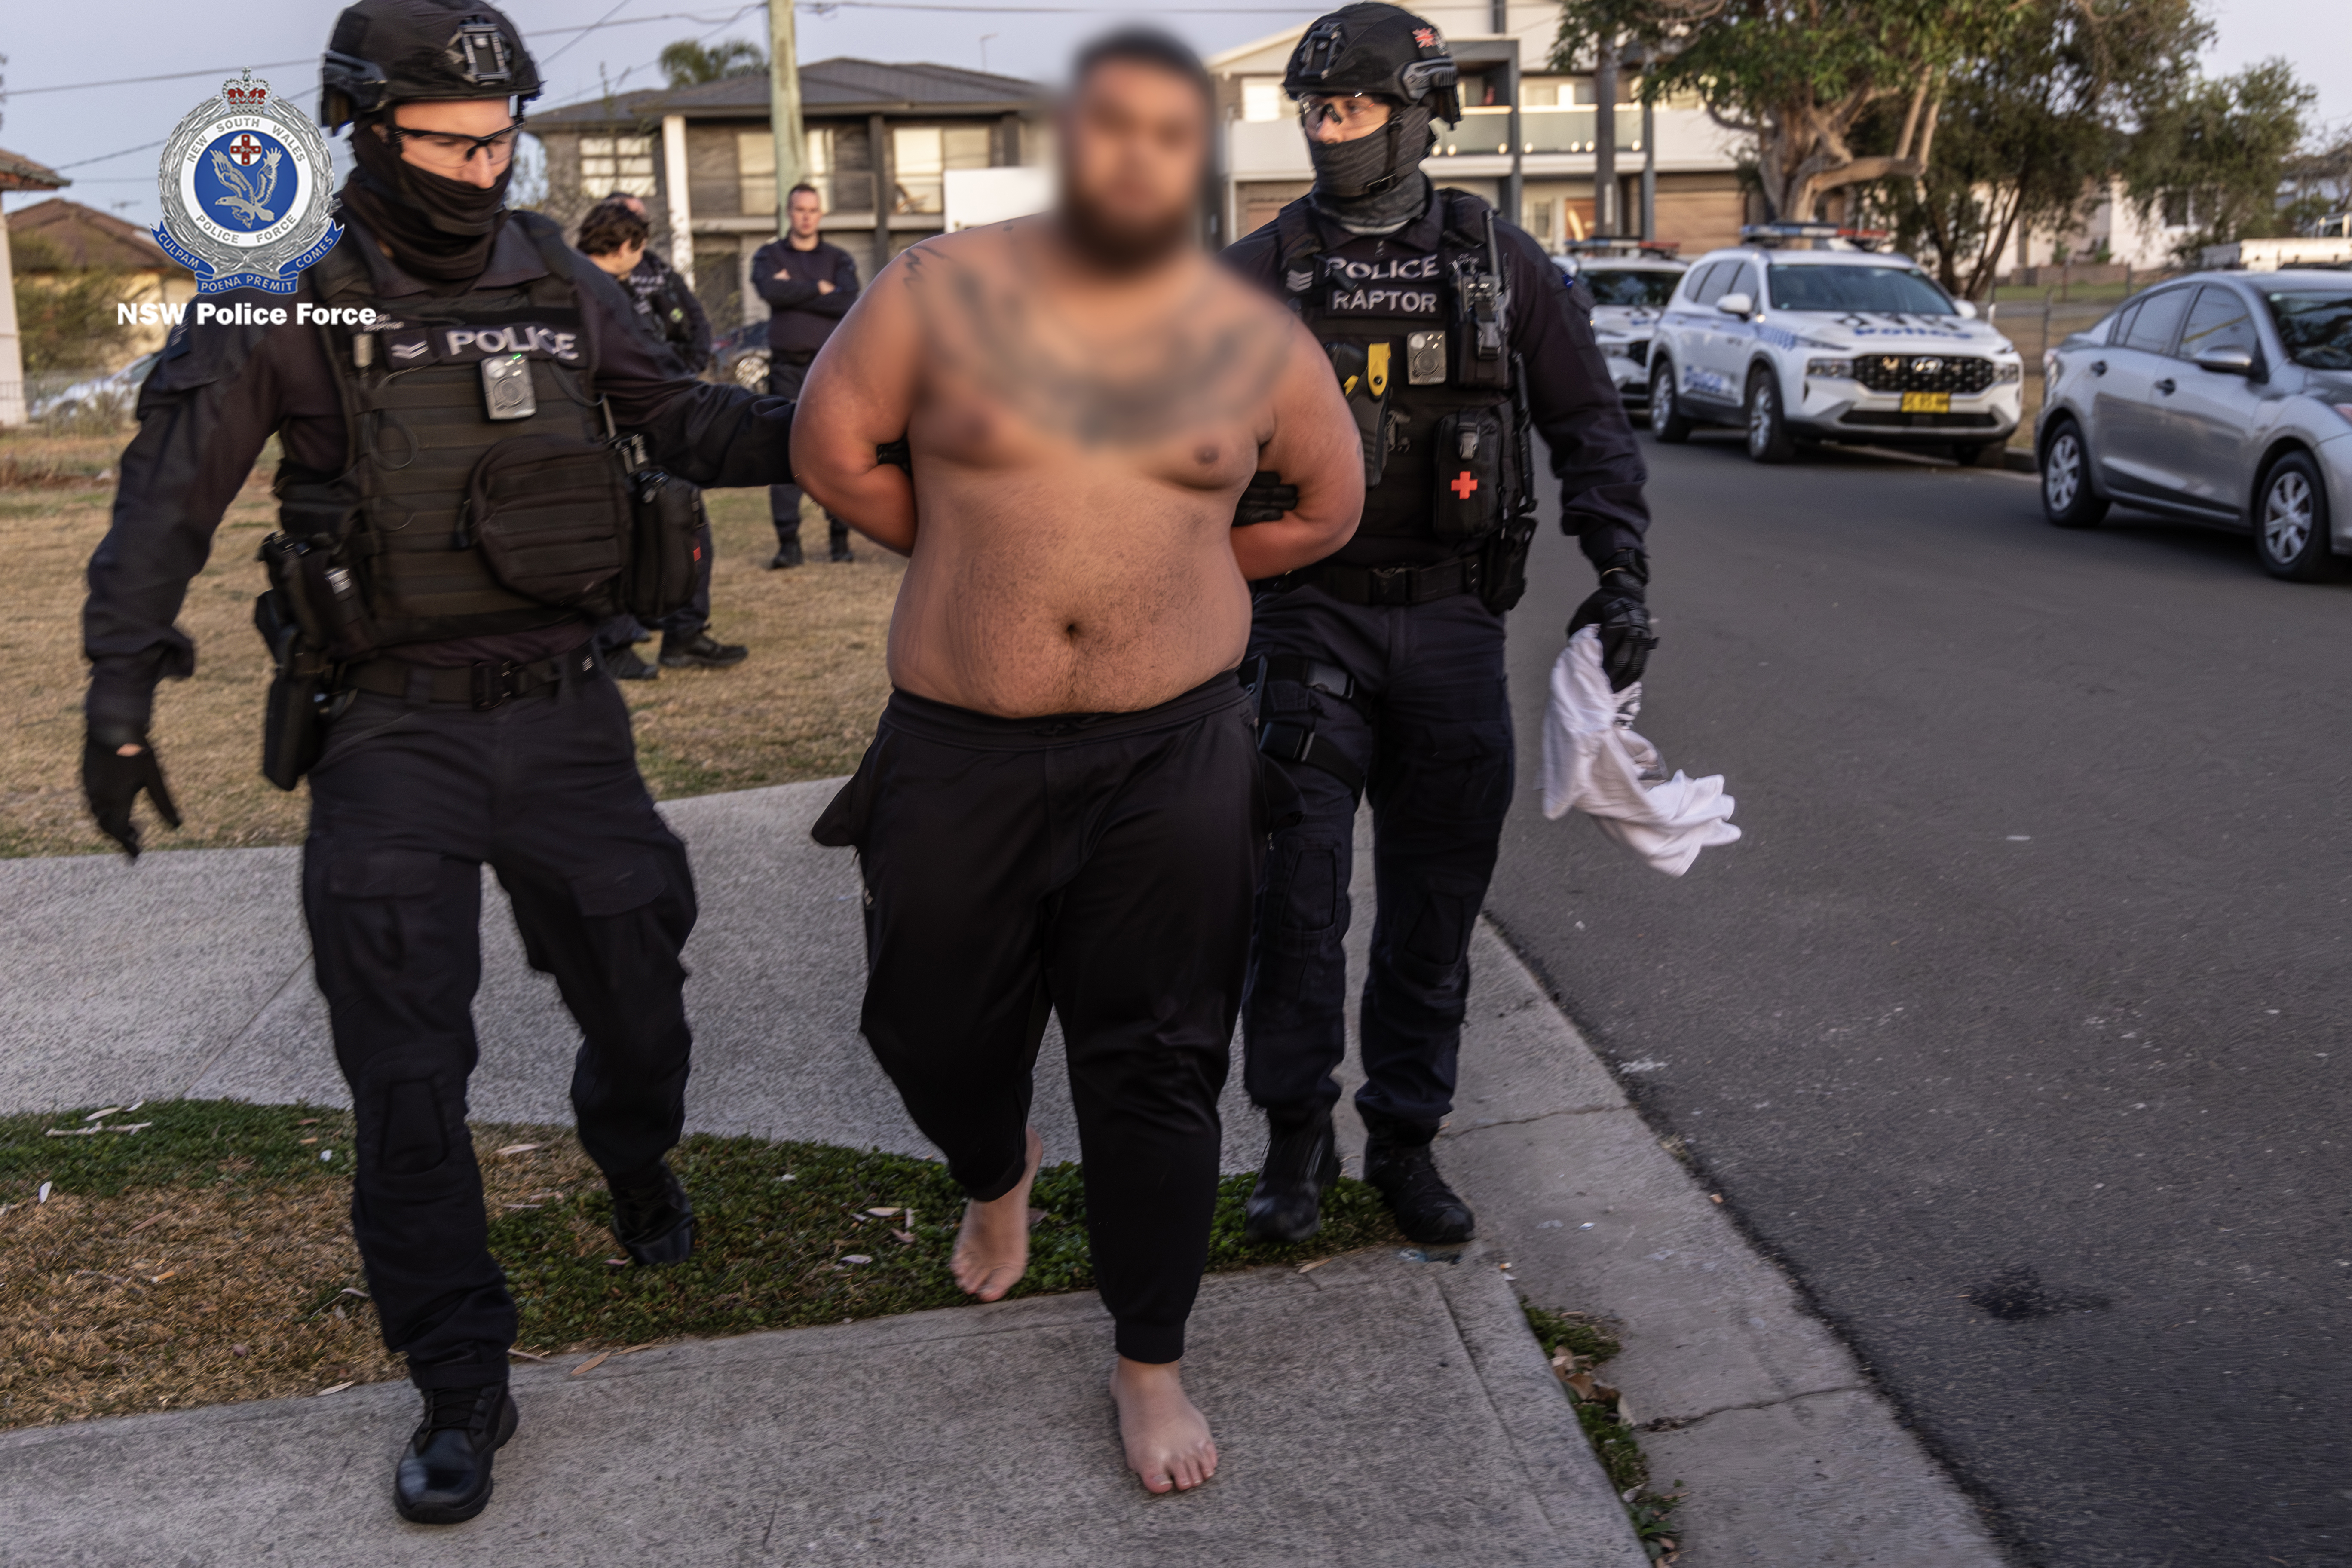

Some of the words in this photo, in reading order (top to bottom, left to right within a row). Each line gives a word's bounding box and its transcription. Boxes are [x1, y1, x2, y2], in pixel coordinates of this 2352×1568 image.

[1324, 254, 1439, 280] POLICE
[1333, 289, 1437, 313] RAPTOR
[446, 326, 579, 360] POLICE
